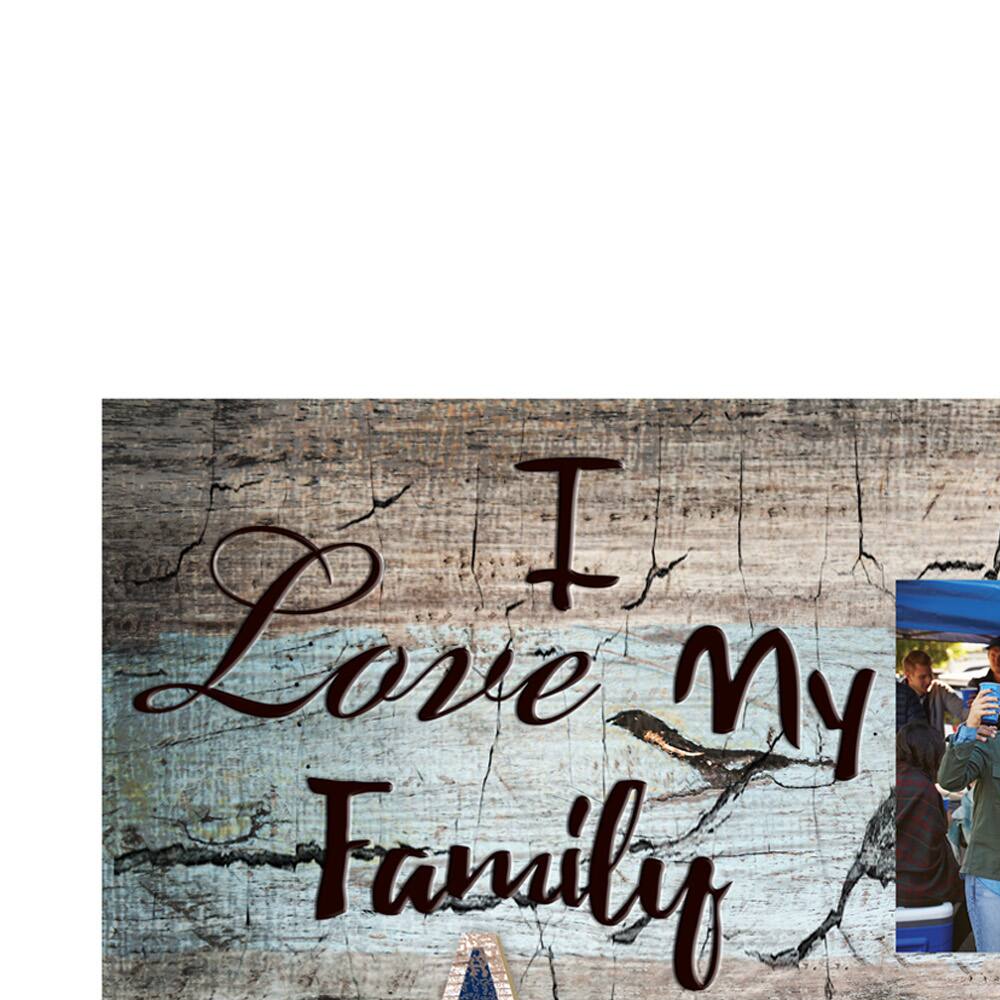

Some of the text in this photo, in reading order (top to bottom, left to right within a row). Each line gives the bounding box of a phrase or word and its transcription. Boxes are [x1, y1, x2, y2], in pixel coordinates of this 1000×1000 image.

[514, 457, 624, 611] I
[132, 525, 878, 782] Love My
[307, 777, 734, 992] Family
